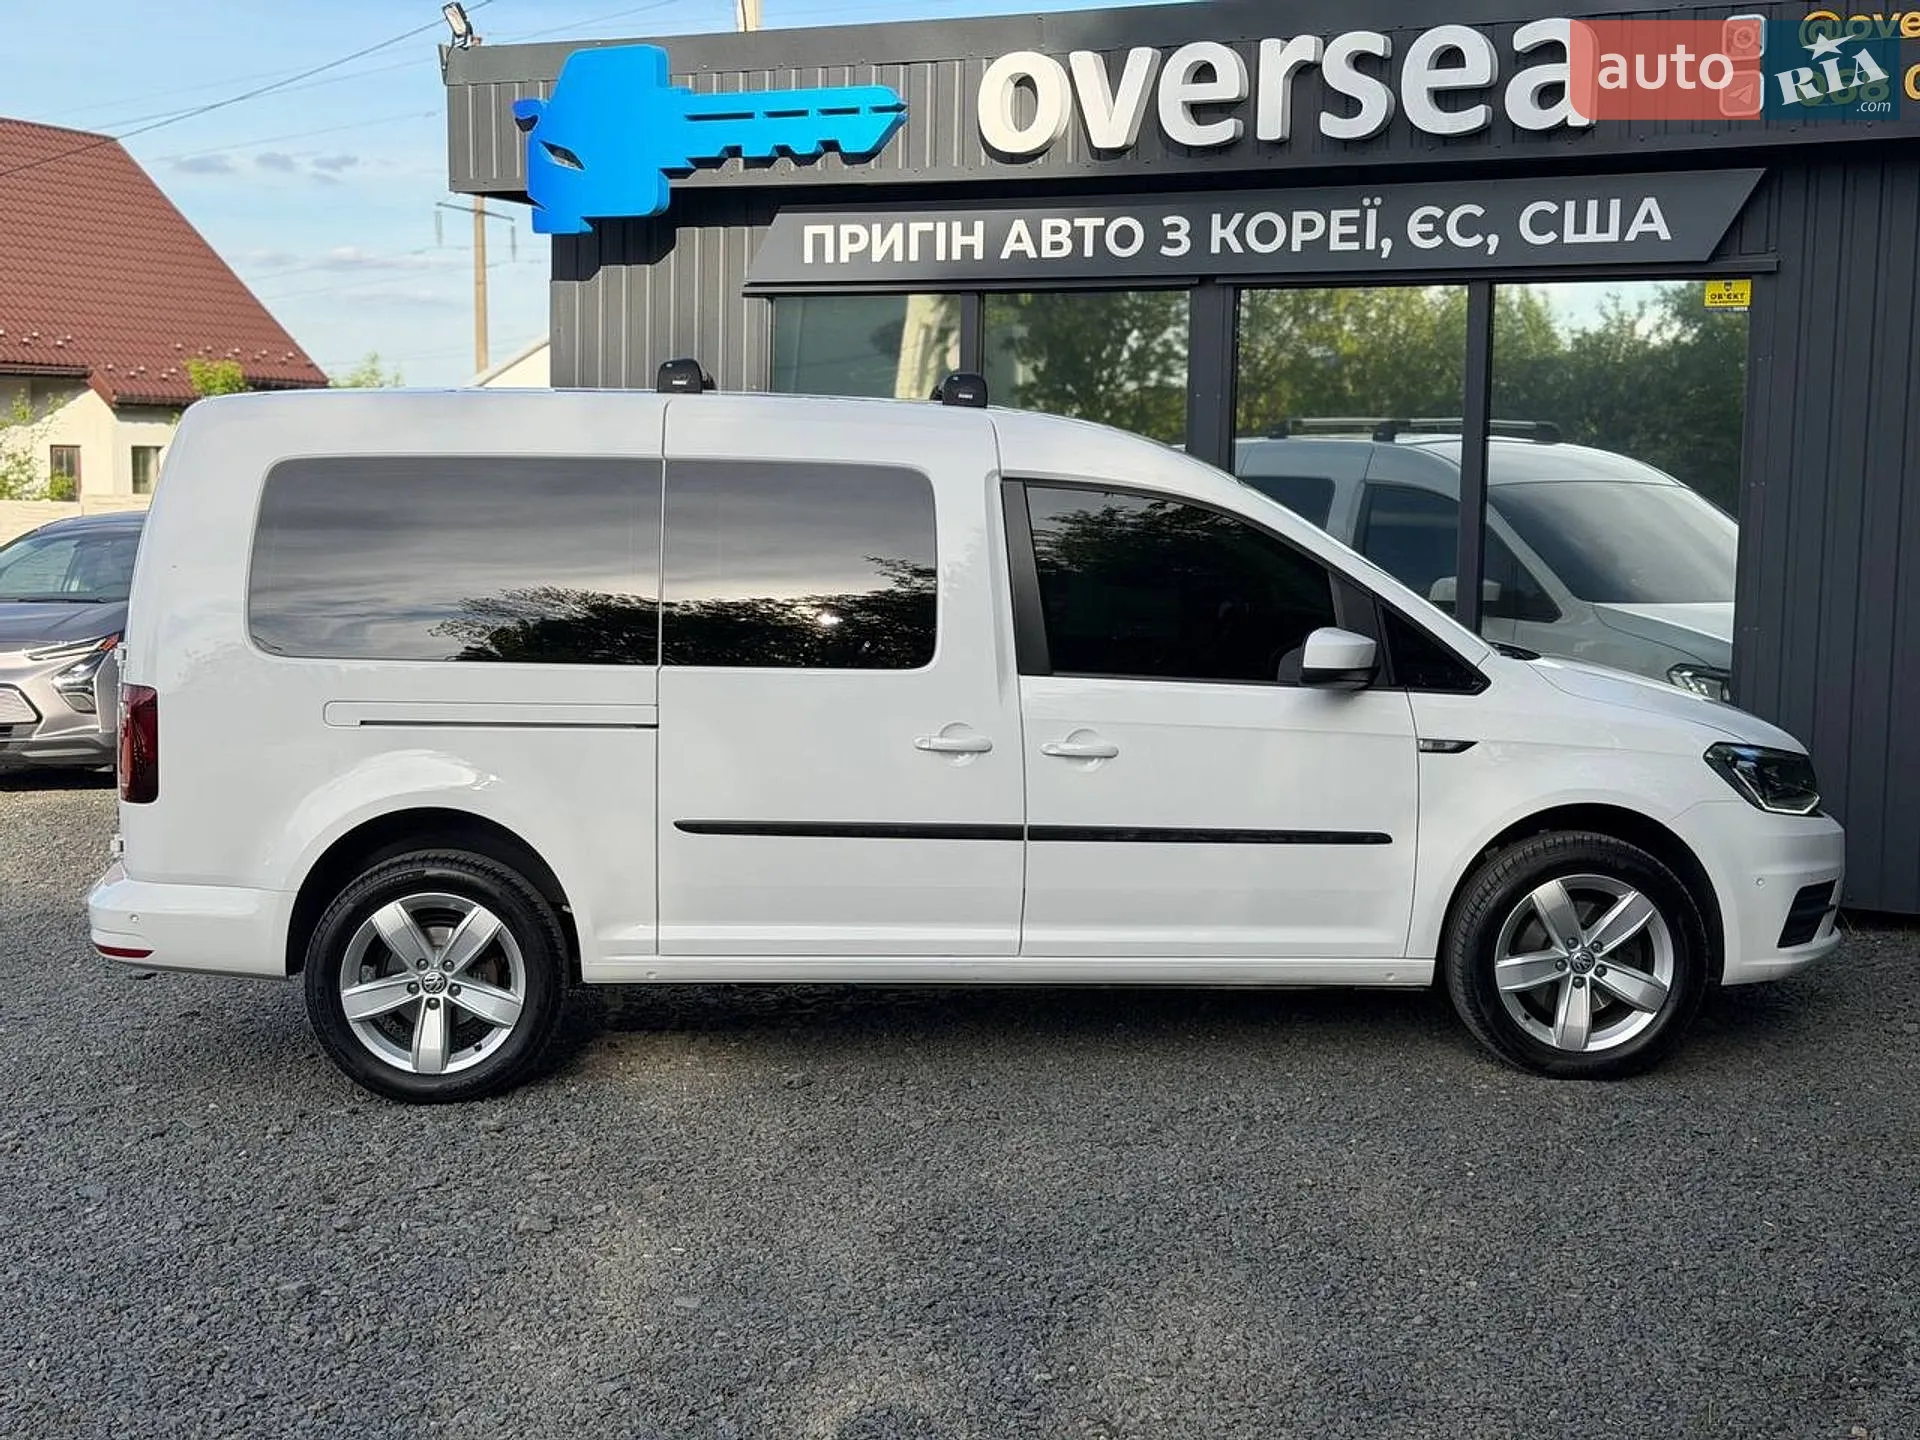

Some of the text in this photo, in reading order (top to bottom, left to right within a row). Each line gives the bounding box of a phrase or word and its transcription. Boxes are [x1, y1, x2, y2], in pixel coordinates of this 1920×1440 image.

[977, 17, 1597, 155] oversea
[803, 220, 985, 264] ПРИГІН
[1000, 216, 1145, 260] АВТО
[1210, 196, 1394, 259] КОРЕЇ,
[1406, 203, 1500, 256] ЄС,
[1519, 196, 1672, 246] США
